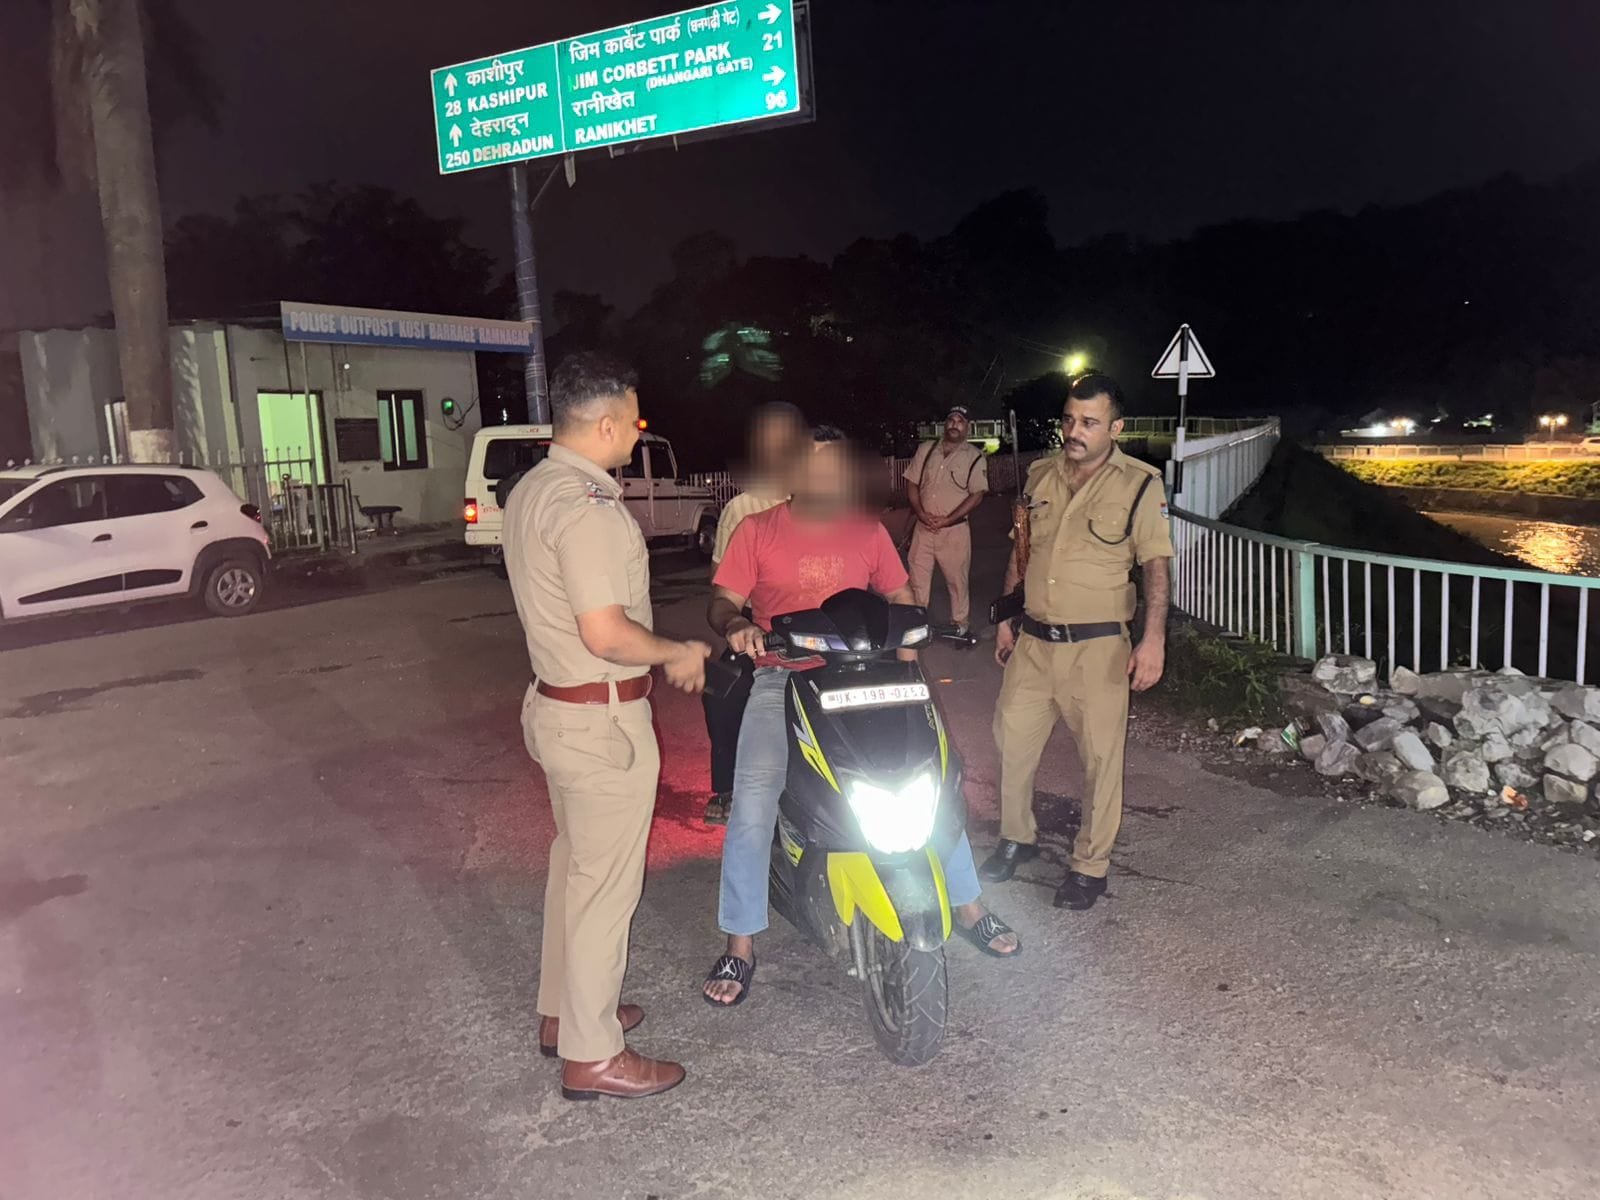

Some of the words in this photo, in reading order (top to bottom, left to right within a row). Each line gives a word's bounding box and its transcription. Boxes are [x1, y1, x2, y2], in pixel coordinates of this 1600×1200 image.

[569, 41, 600, 64] जिम
[649, 17, 681, 45] पार्क
[762, 31, 783, 51] 21
[465, 59, 524, 86] काशीपुर
[572, 72, 598, 91] JIM
[603, 53, 679, 83] CORBETT
[684, 41, 731, 67] PARK
[716, 57, 753, 75] GATE)
[445, 100, 462, 117] 28
[467, 82, 548, 112] KASHIPUR
[571, 88, 635, 117] रानीखेत
[765, 90, 788, 110] 96
[469, 116, 529, 137] देहरादून
[575, 115, 657, 144] RANIKHET
[445, 150, 470, 169] 250
[473, 133, 554, 162] DEHRADUN
[290, 311, 337, 334] POLICE
[340, 315, 394, 337] OUTPOST
[399, 319, 425, 340] KOSI
[429, 322, 476, 343] BARRAGE
